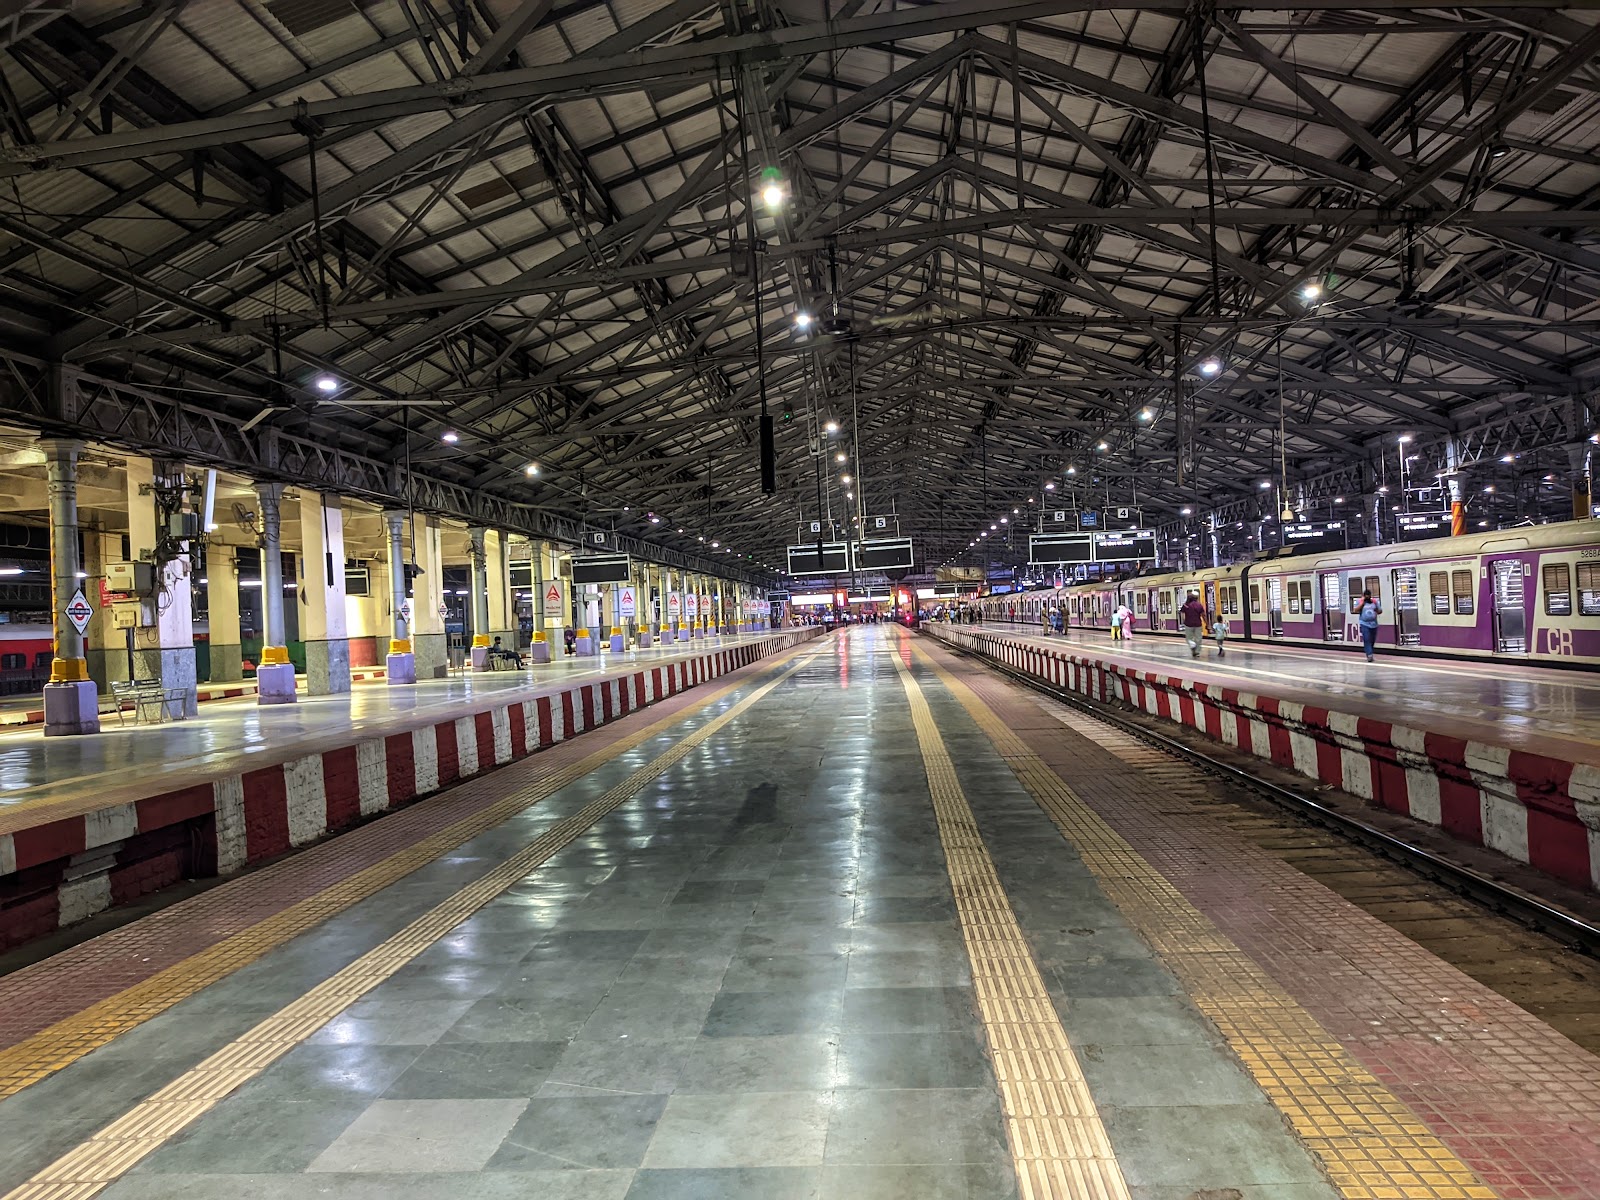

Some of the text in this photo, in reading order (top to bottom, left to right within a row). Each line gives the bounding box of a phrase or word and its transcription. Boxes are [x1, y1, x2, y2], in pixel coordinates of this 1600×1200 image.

[812, 523, 819, 531] 6
[597, 534, 602, 542] 6
[1547, 628, 1573, 656] CR
